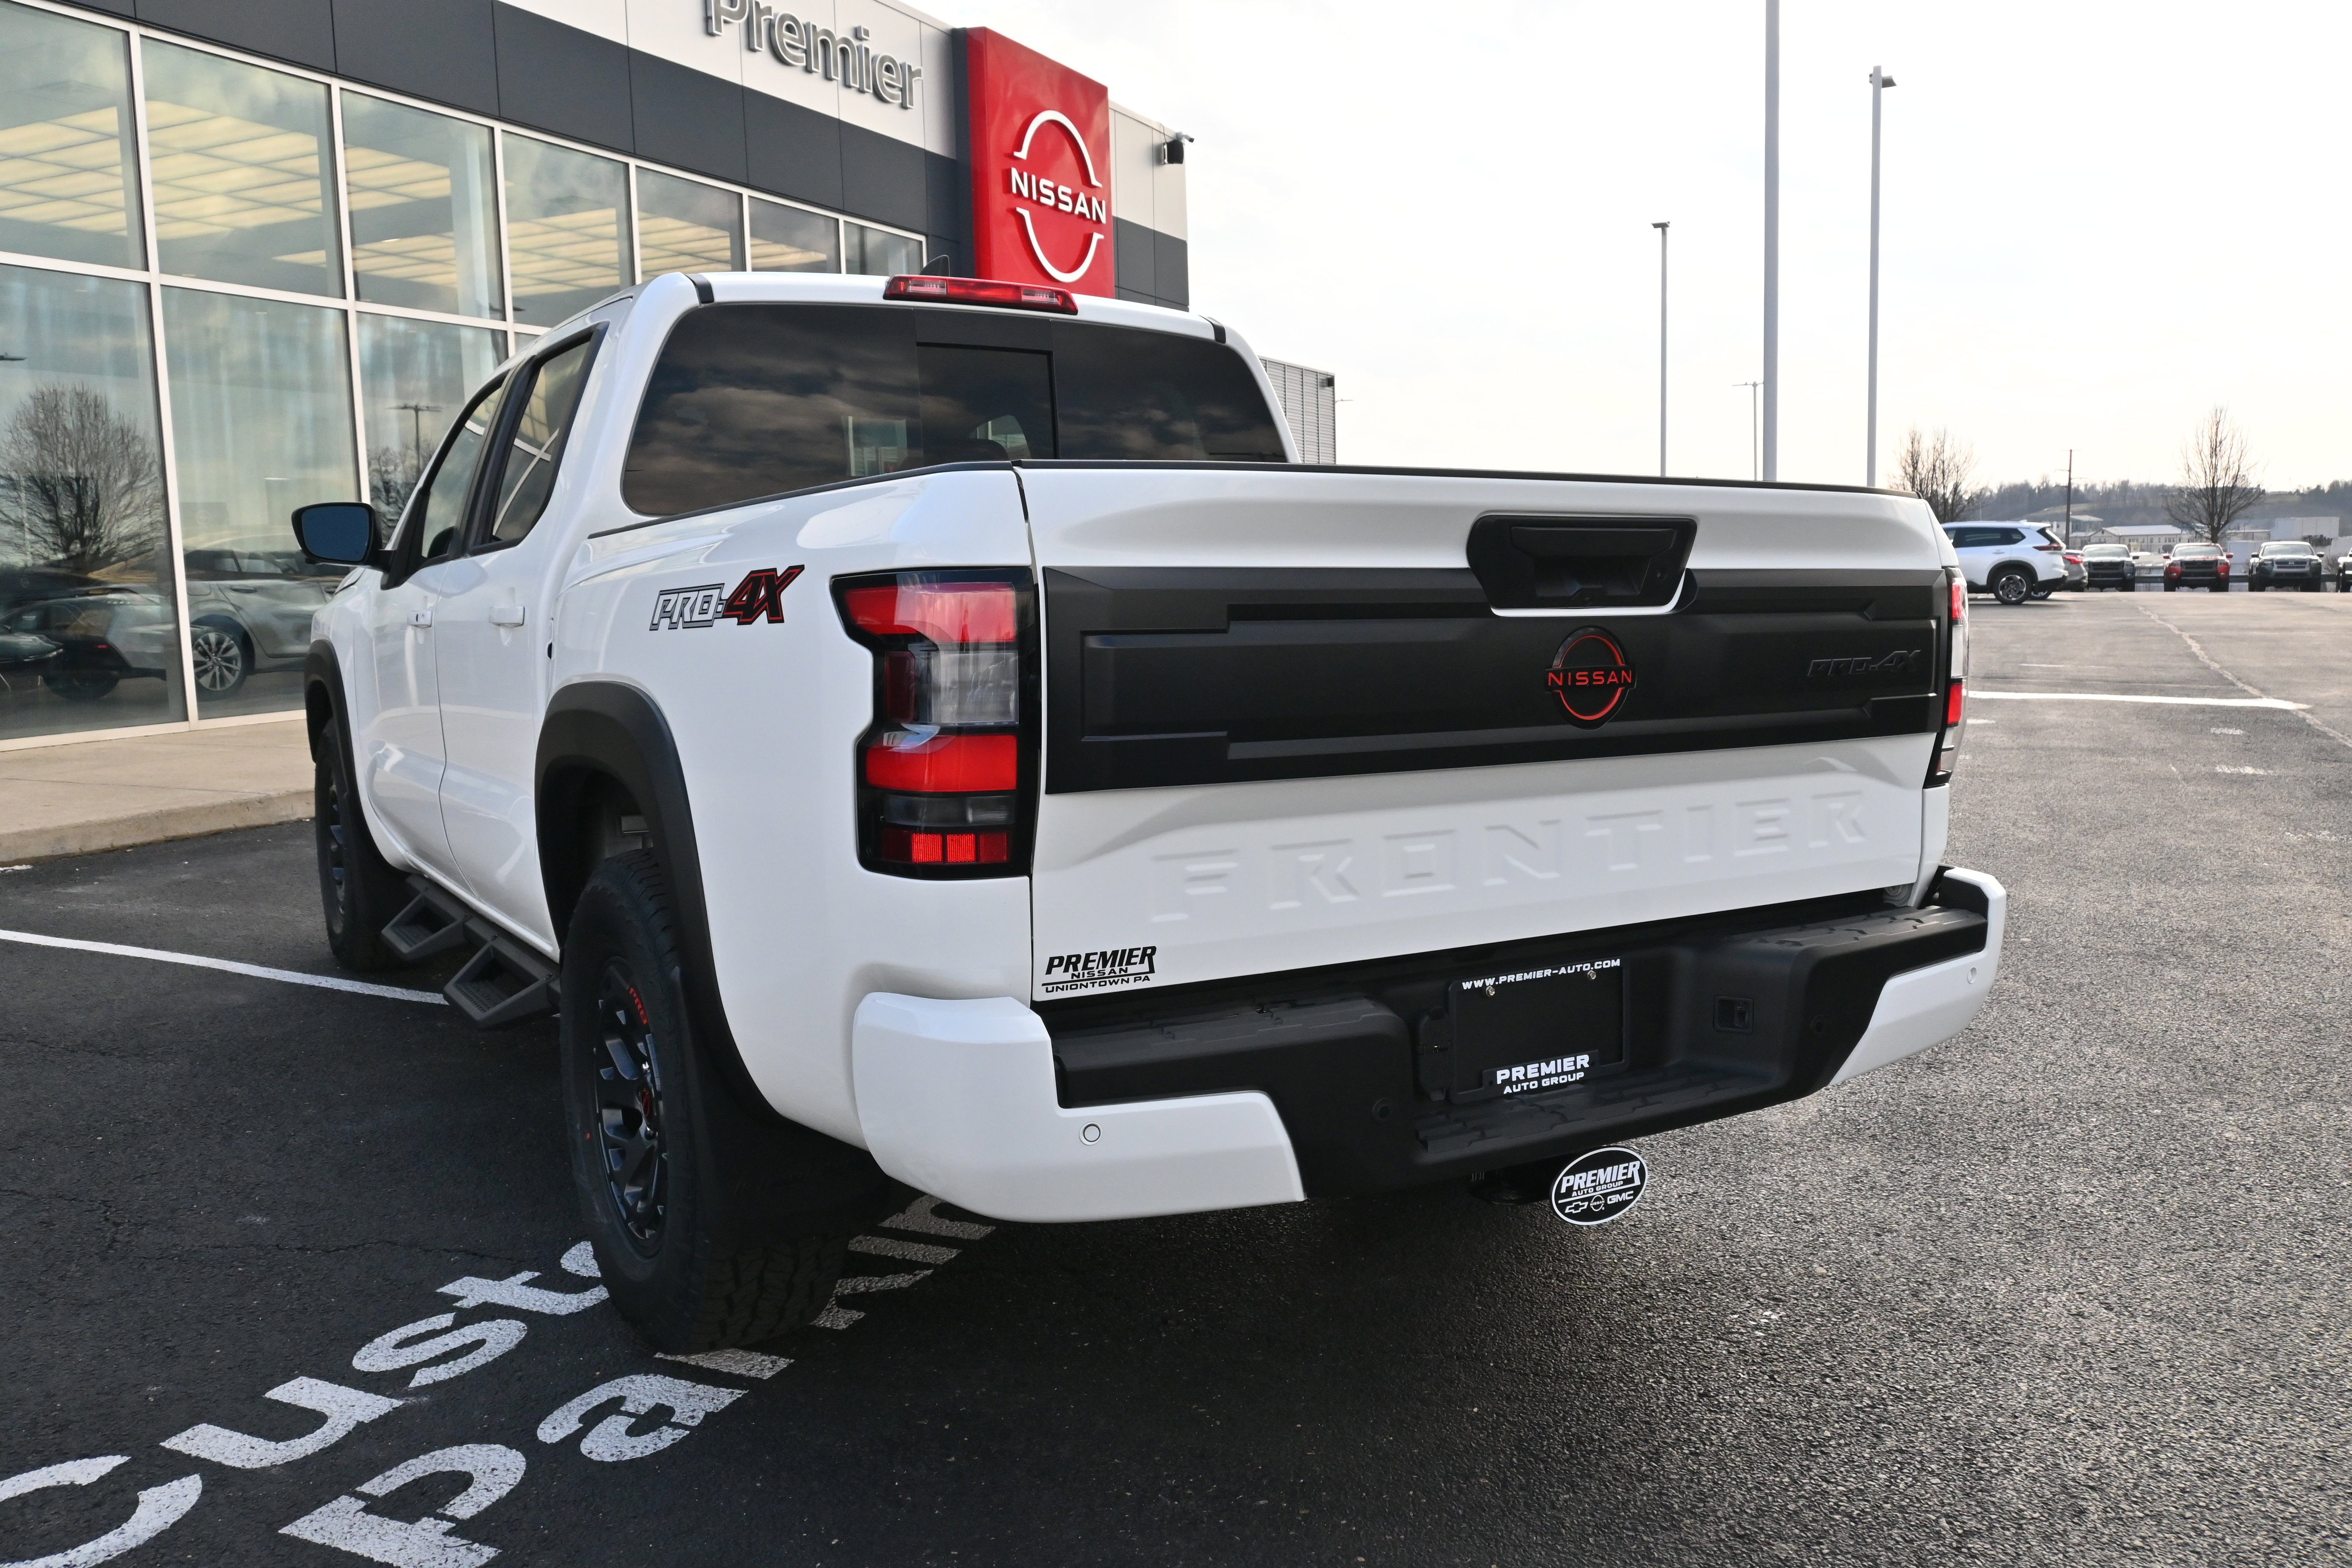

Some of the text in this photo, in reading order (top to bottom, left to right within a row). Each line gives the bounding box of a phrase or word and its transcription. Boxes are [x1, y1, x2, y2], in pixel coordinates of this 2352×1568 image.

[1011, 166, 1106, 224] NISSAN
[649, 564, 805, 631] PRO-4X
[1548, 670, 1632, 686] NISSAN
[1150, 790, 1866, 921] FRONTIER
[1045, 946, 1157, 975] PREMIER
[1071, 967, 1128, 980] NISSAN
[1462, 958, 1620, 990] WWW.PREMIER-AUTO.COM
[1045, 977, 1130, 993] UNIONTOWN
[1496, 1054, 1590, 1085] PREMIER
[1503, 1072, 1584, 1094] AUTO GROUP
[1560, 1161, 1641, 1193] PREMIER
[1571, 1181, 1624, 1197] AUTO GROUP
[1607, 1190, 1634, 1204] GMC
